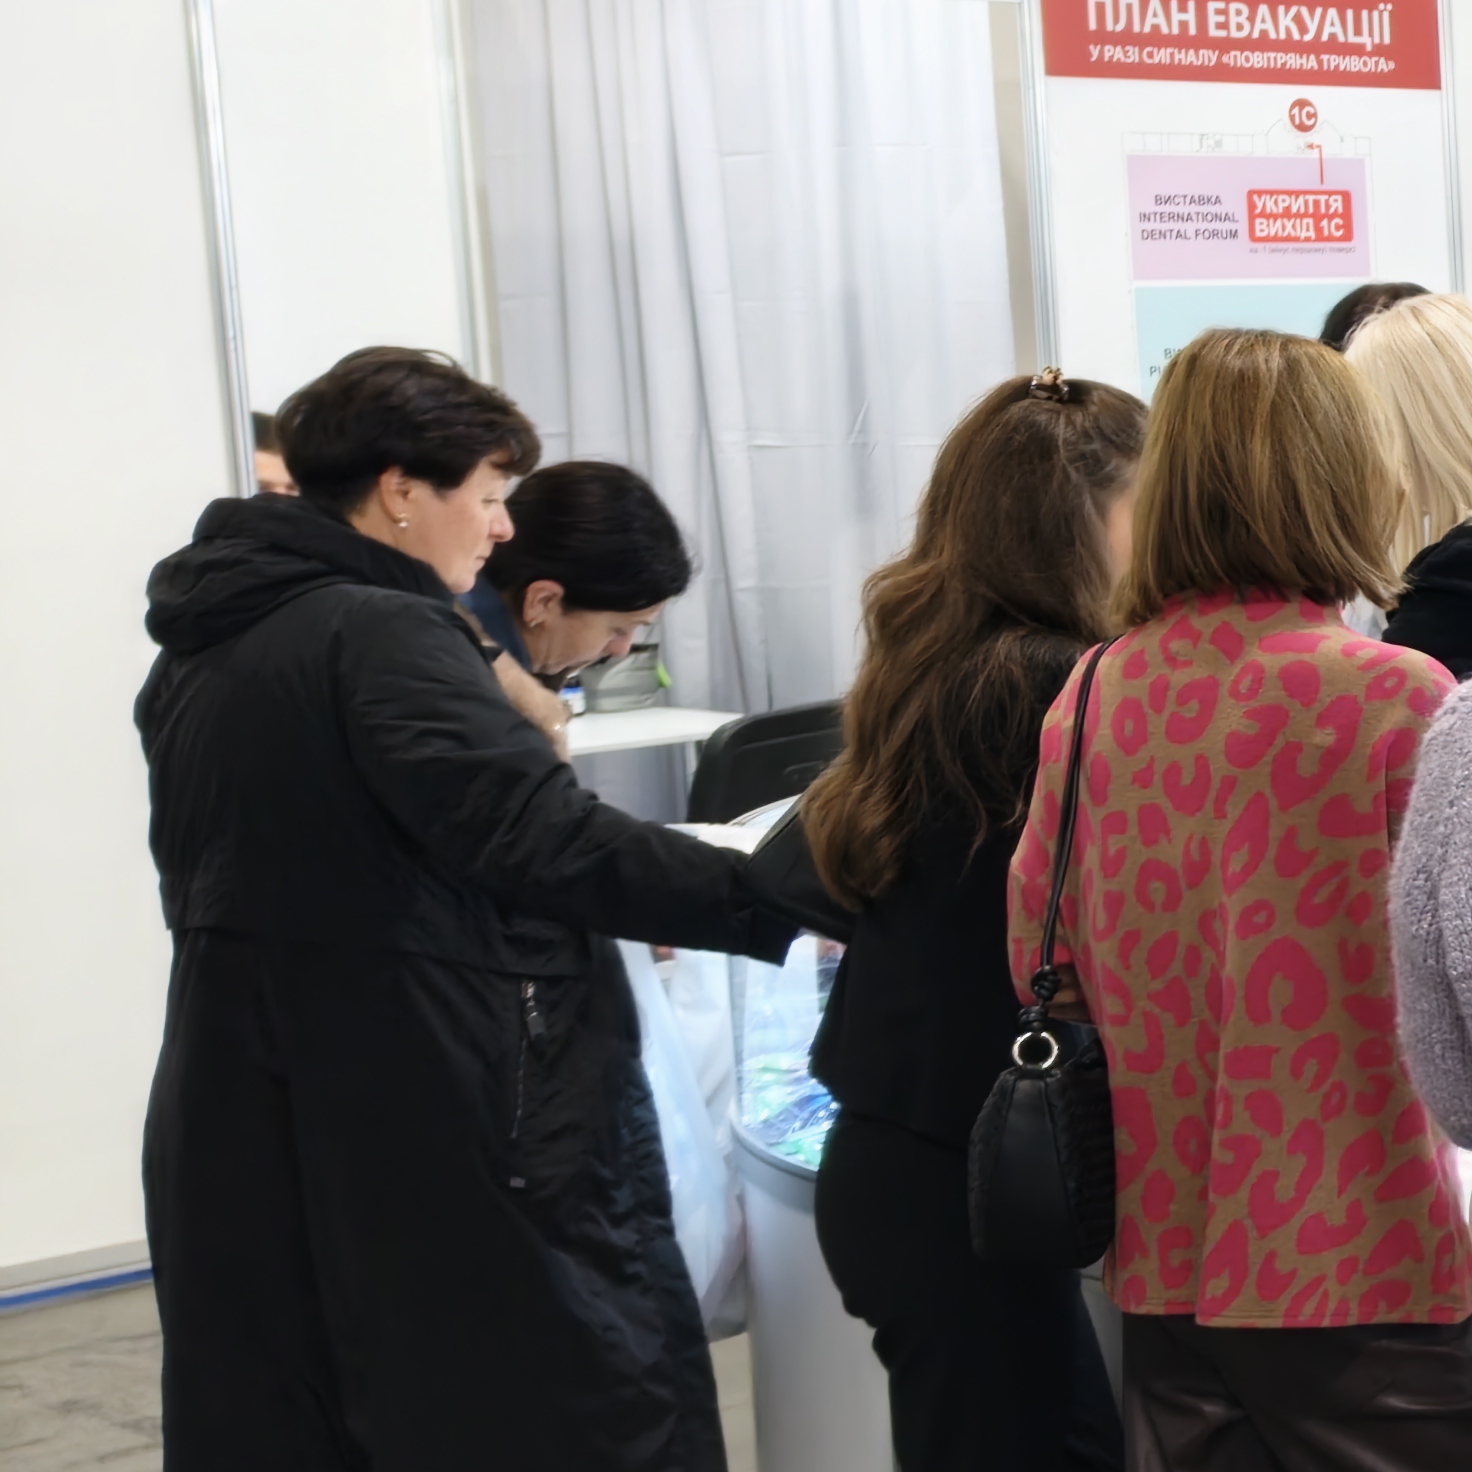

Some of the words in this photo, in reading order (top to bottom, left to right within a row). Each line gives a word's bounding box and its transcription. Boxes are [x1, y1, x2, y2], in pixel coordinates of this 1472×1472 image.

[1207, 1, 1392, 51] ЕВАКУАЦІЇ
[1089, 45, 1102, 62] У
[1104, 45, 1139, 63] РАЗІ
[1142, 47, 1219, 67] СИГНАЛУ
[1221, 50, 1318, 71] «ПОВІТРЯНА
[1320, 54, 1395, 73] ТРИВОГА»
[1291, 106, 1315, 125] 1C
[1154, 194, 1222, 206] ВИСТАВКА
[1253, 194, 1343, 214] УКРИТТЯ
[1139, 212, 1239, 224] INTERNATIONAL
[1141, 229, 1191, 241] DENTAL
[1195, 228, 1239, 240] FORUM
[1255, 218, 1315, 239] ВИХІД
[1320, 218, 1343, 236] 1C
